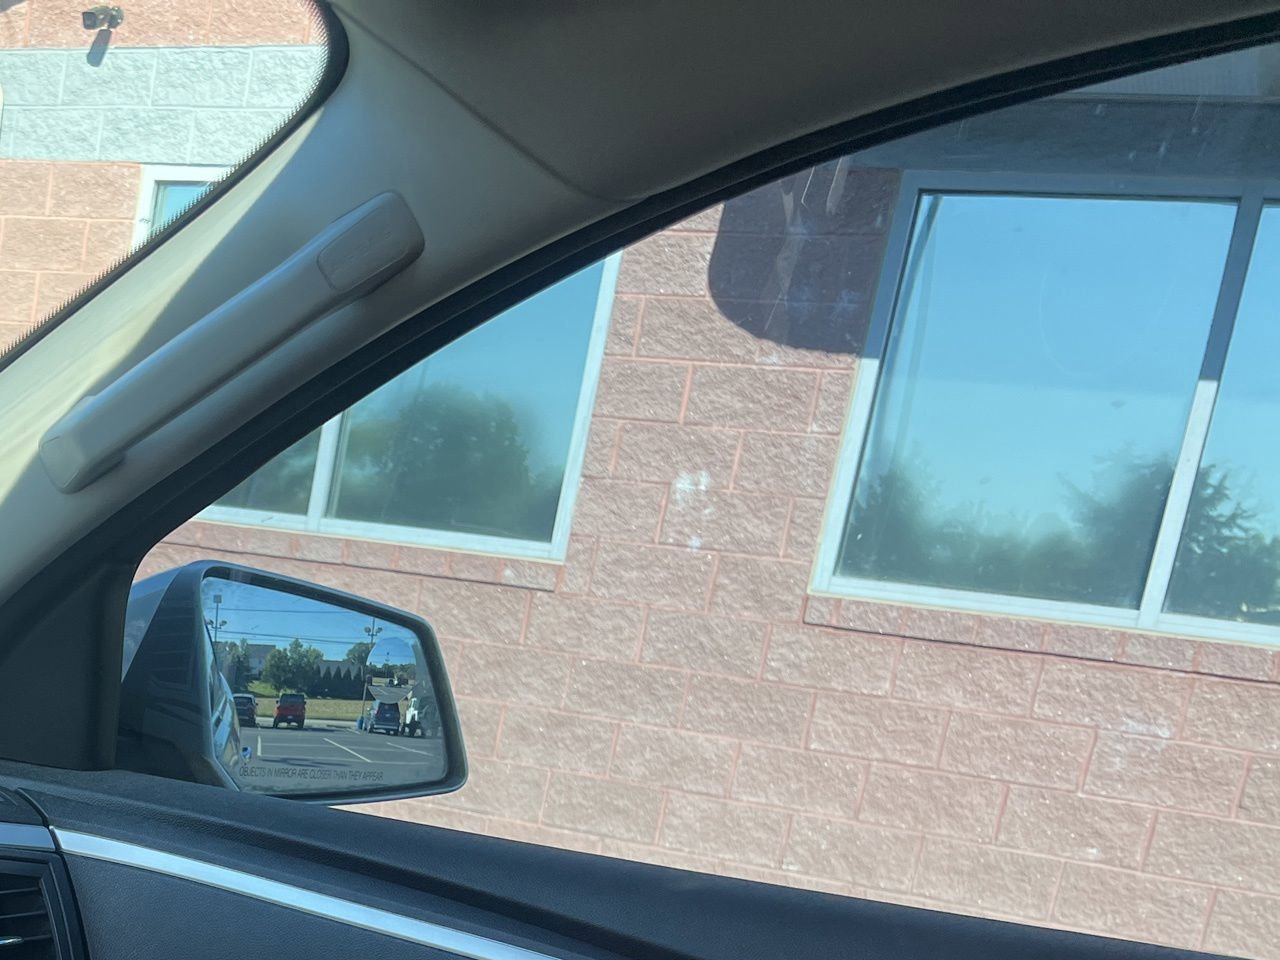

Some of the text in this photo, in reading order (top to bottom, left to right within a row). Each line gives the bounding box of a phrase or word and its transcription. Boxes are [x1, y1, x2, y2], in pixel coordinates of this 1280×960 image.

[239, 766, 385, 781] OBJECTS IN MIRROR ARE CLOSER THAN THEY APPEAR
